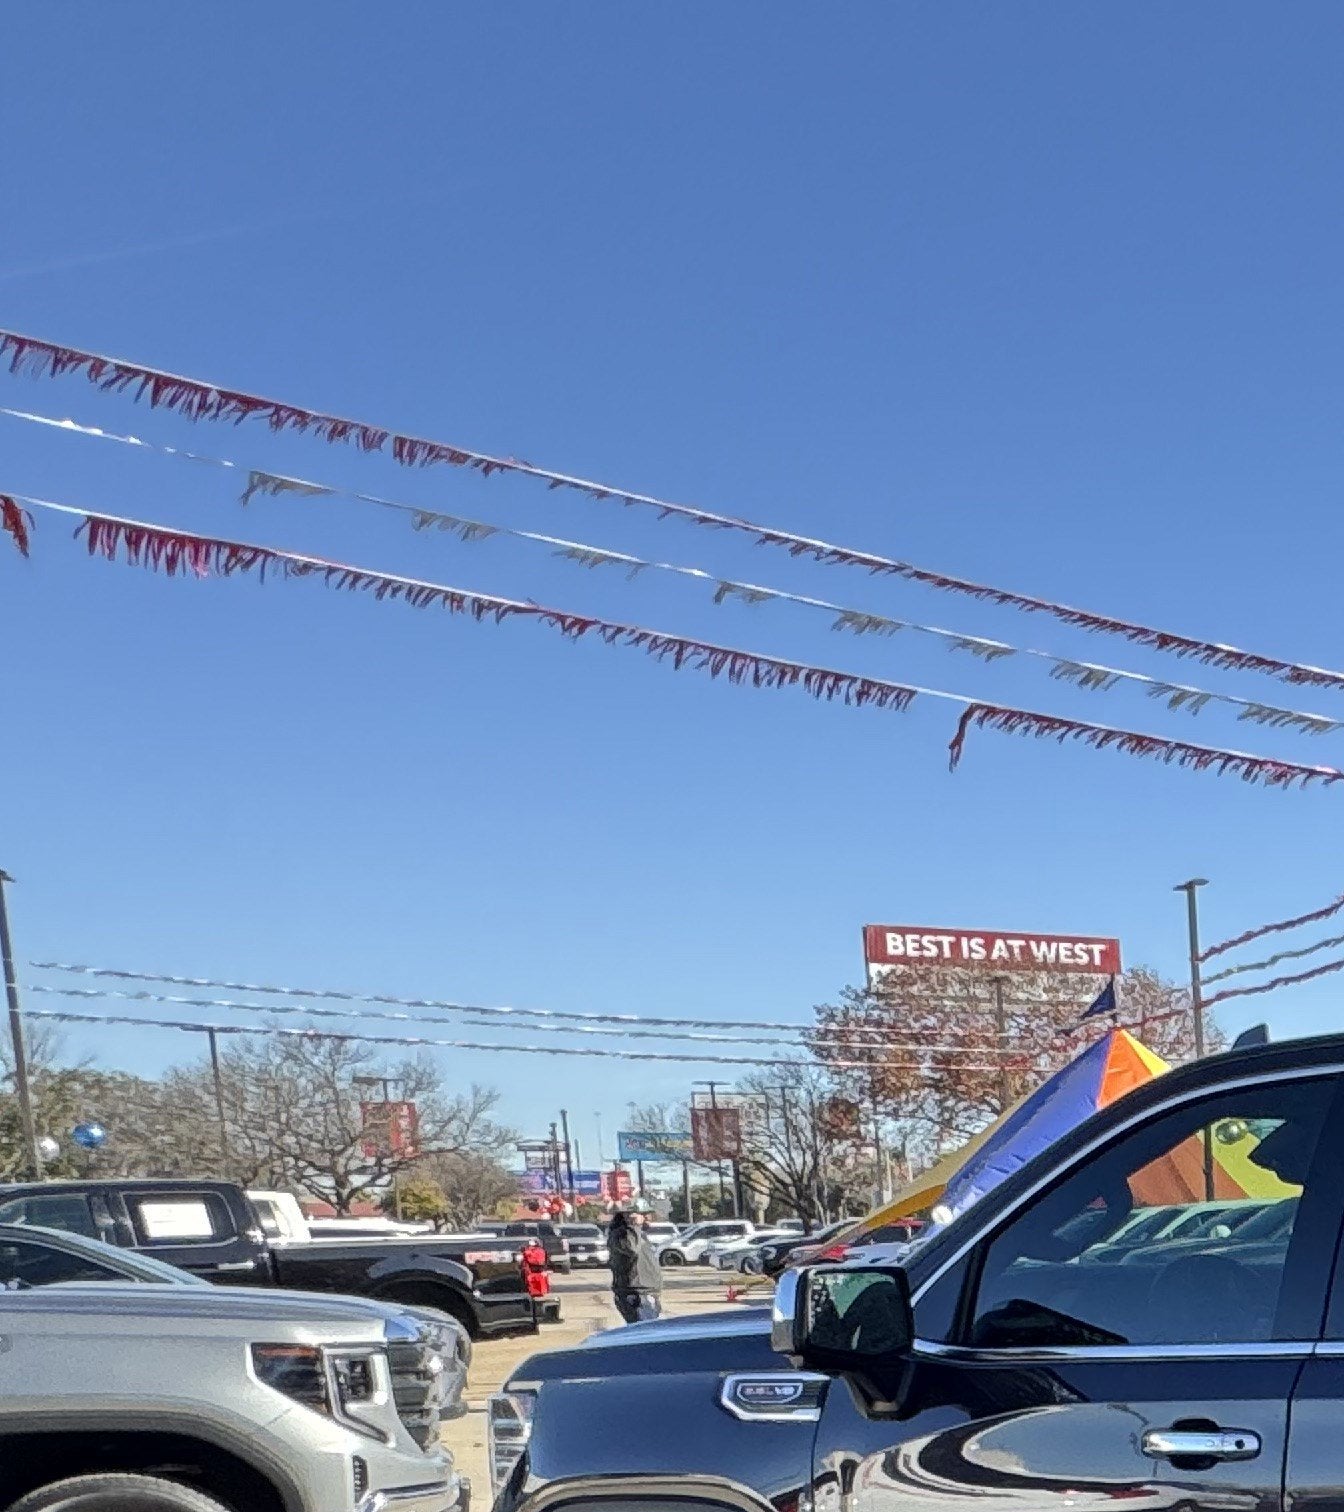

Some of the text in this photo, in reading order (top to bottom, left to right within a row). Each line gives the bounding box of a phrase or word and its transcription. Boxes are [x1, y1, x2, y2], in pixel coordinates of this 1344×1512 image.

[885, 932, 1107, 967] BEST IS AT WEST
